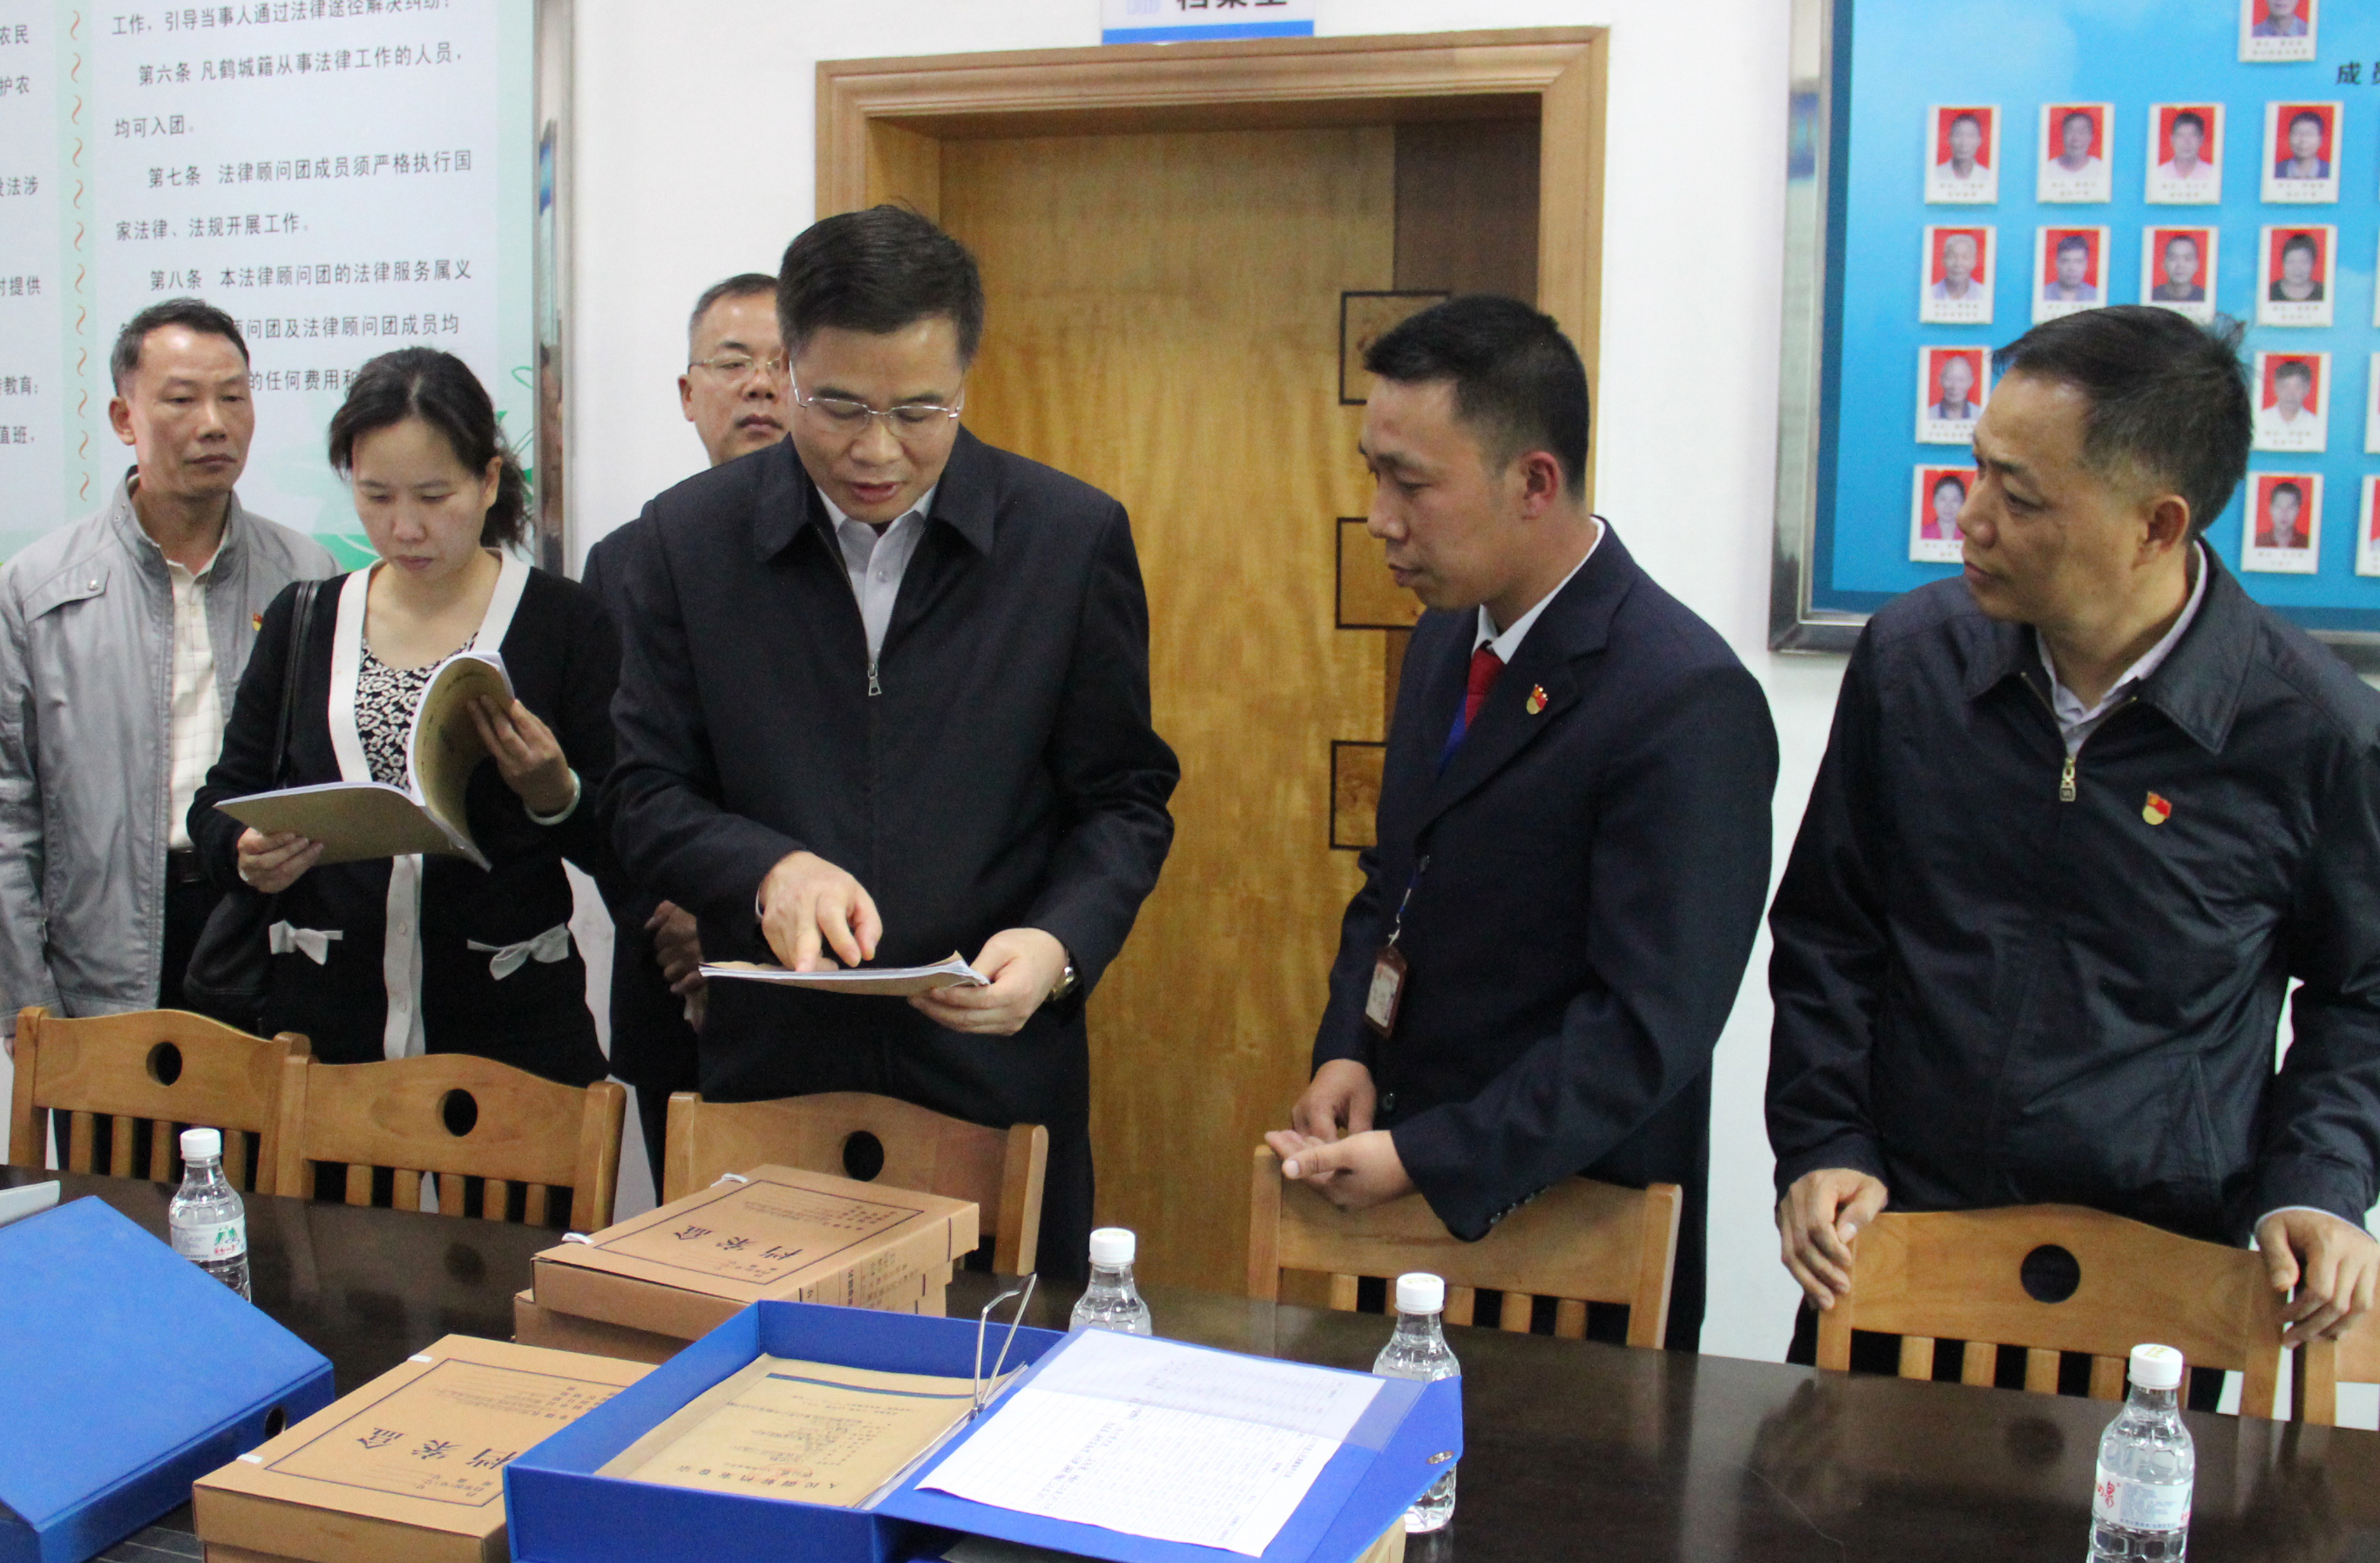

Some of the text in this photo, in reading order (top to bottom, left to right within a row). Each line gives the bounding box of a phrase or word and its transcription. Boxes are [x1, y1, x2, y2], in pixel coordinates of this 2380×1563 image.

[139, 41, 462, 86] 第六条 凡鹤城籍从事法律工作的人员，
[115, 115, 196, 138] 均可入团。
[0, 174, 38, 197] 法涉
[148, 149, 471, 188] 第七条 法律顾问团成员须严格执行国
[116, 213, 311, 241] 家法律、法规开展工作。
[150, 259, 471, 291] 第八条 本法律顾问团的法律服务属义
[675, 1224, 804, 1262] 档案盒
[356, 1428, 518, 1471] 档案盒
